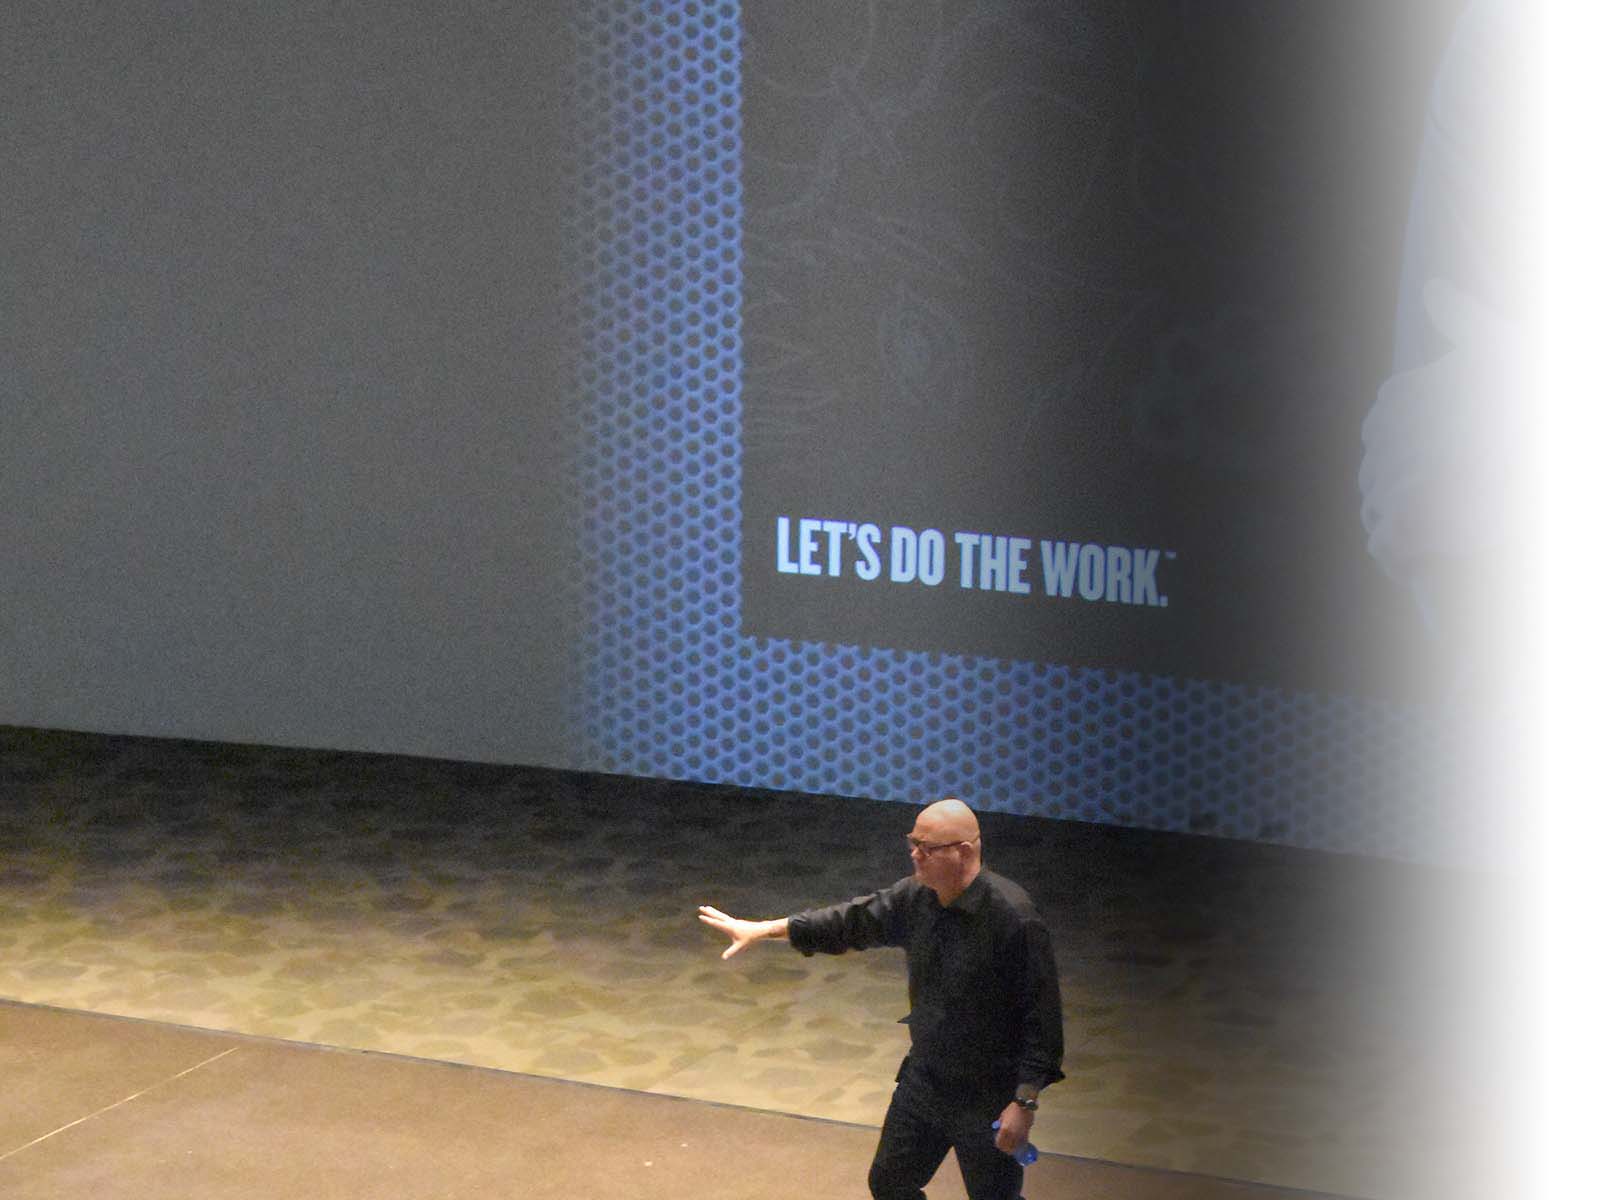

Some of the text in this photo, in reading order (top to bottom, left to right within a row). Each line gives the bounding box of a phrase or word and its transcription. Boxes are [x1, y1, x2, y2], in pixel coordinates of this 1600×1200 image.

[776, 516, 1168, 607] LET'S DO THE WORK.
